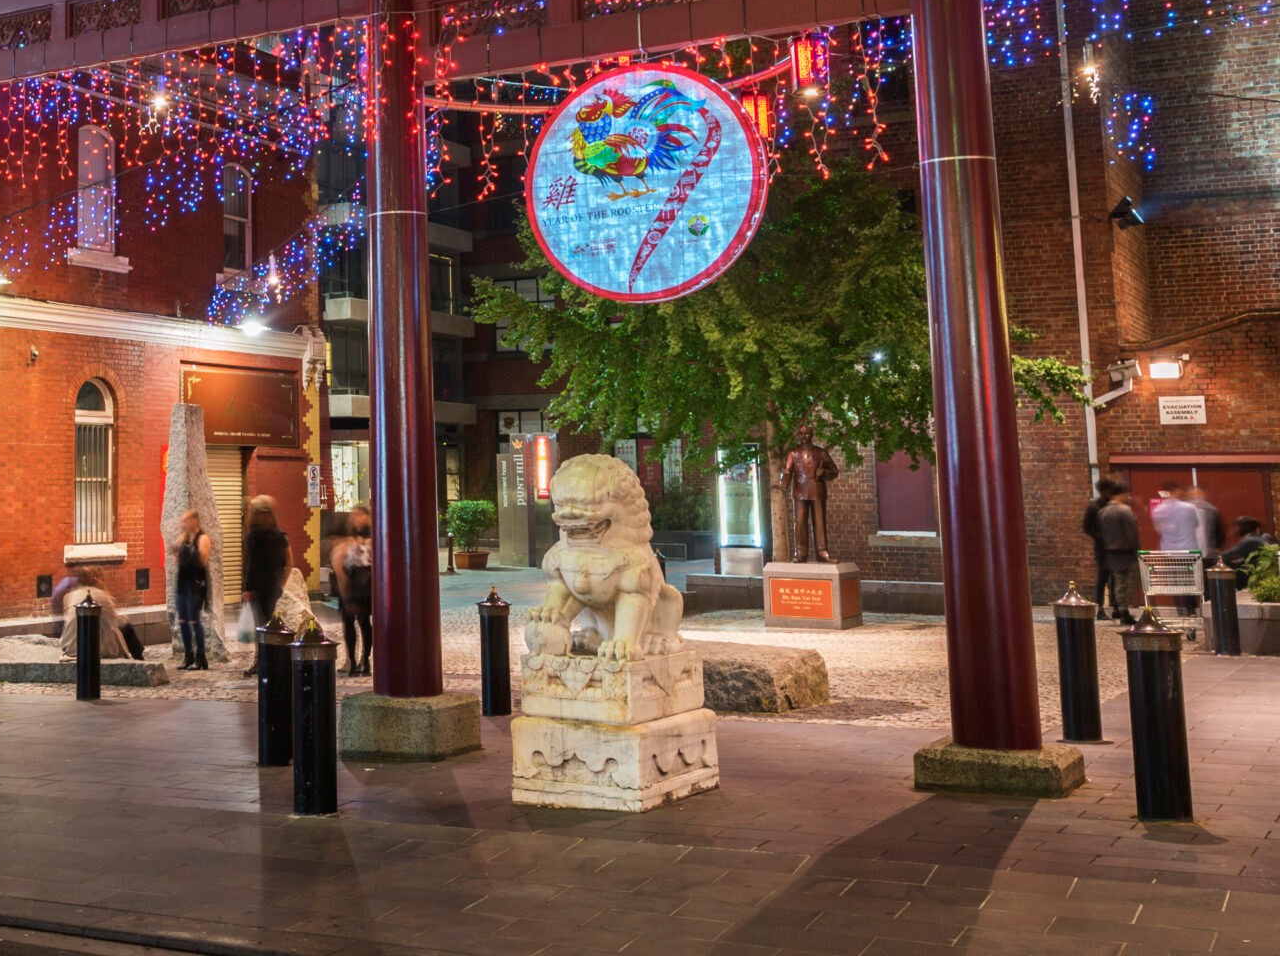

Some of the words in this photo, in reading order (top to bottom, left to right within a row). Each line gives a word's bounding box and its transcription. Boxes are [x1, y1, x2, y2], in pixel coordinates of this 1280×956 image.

[541, 216, 570, 227] YEAR
[570, 213, 584, 223] OF
[586, 209, 608, 220] THE
[610, 202, 661, 217] ROOSTER
